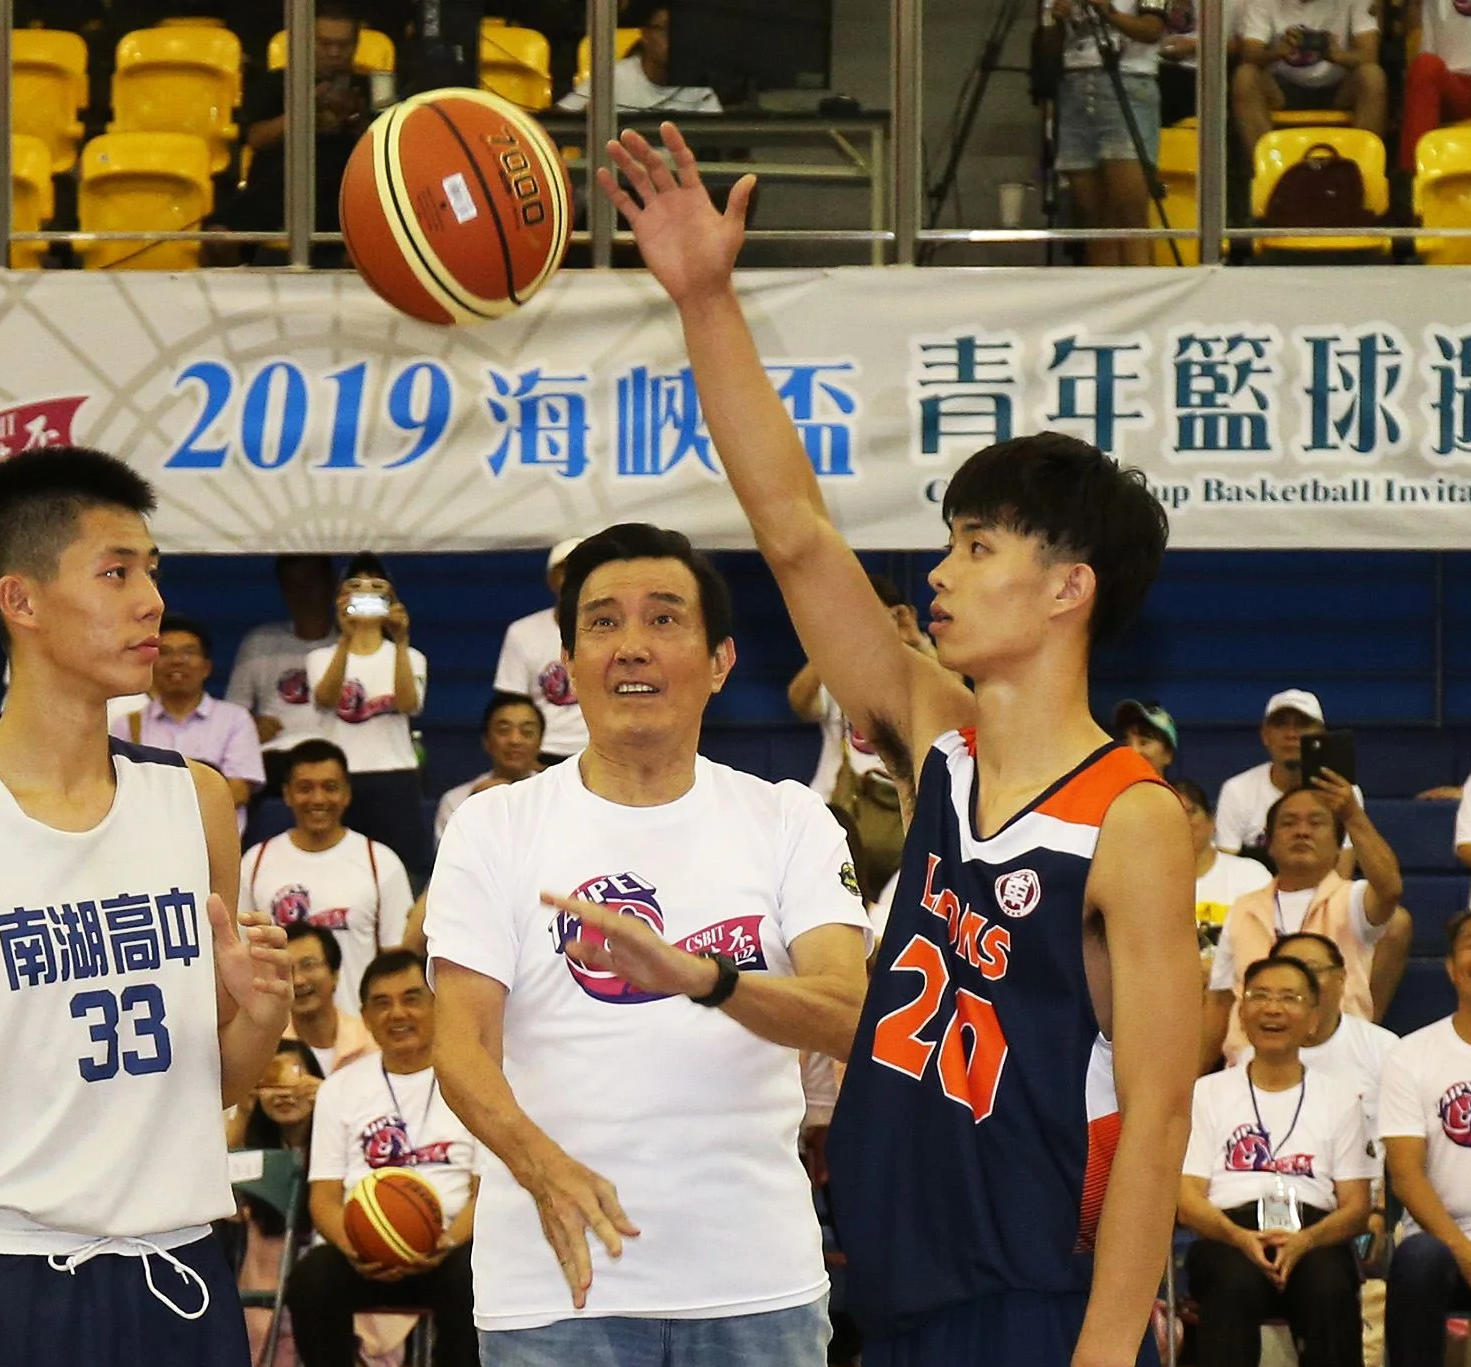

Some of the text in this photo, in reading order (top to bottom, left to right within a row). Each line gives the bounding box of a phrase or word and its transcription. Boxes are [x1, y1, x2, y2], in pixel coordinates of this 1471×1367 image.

[163, 361, 453, 469] 2019
[487, 363, 856, 477] 海峽盃
[1203, 478, 1370, 504] Basketball
[685, 925, 726, 953] CSBIT
[69, 984, 173, 1083] 33
[871, 934, 1009, 1125] 20
